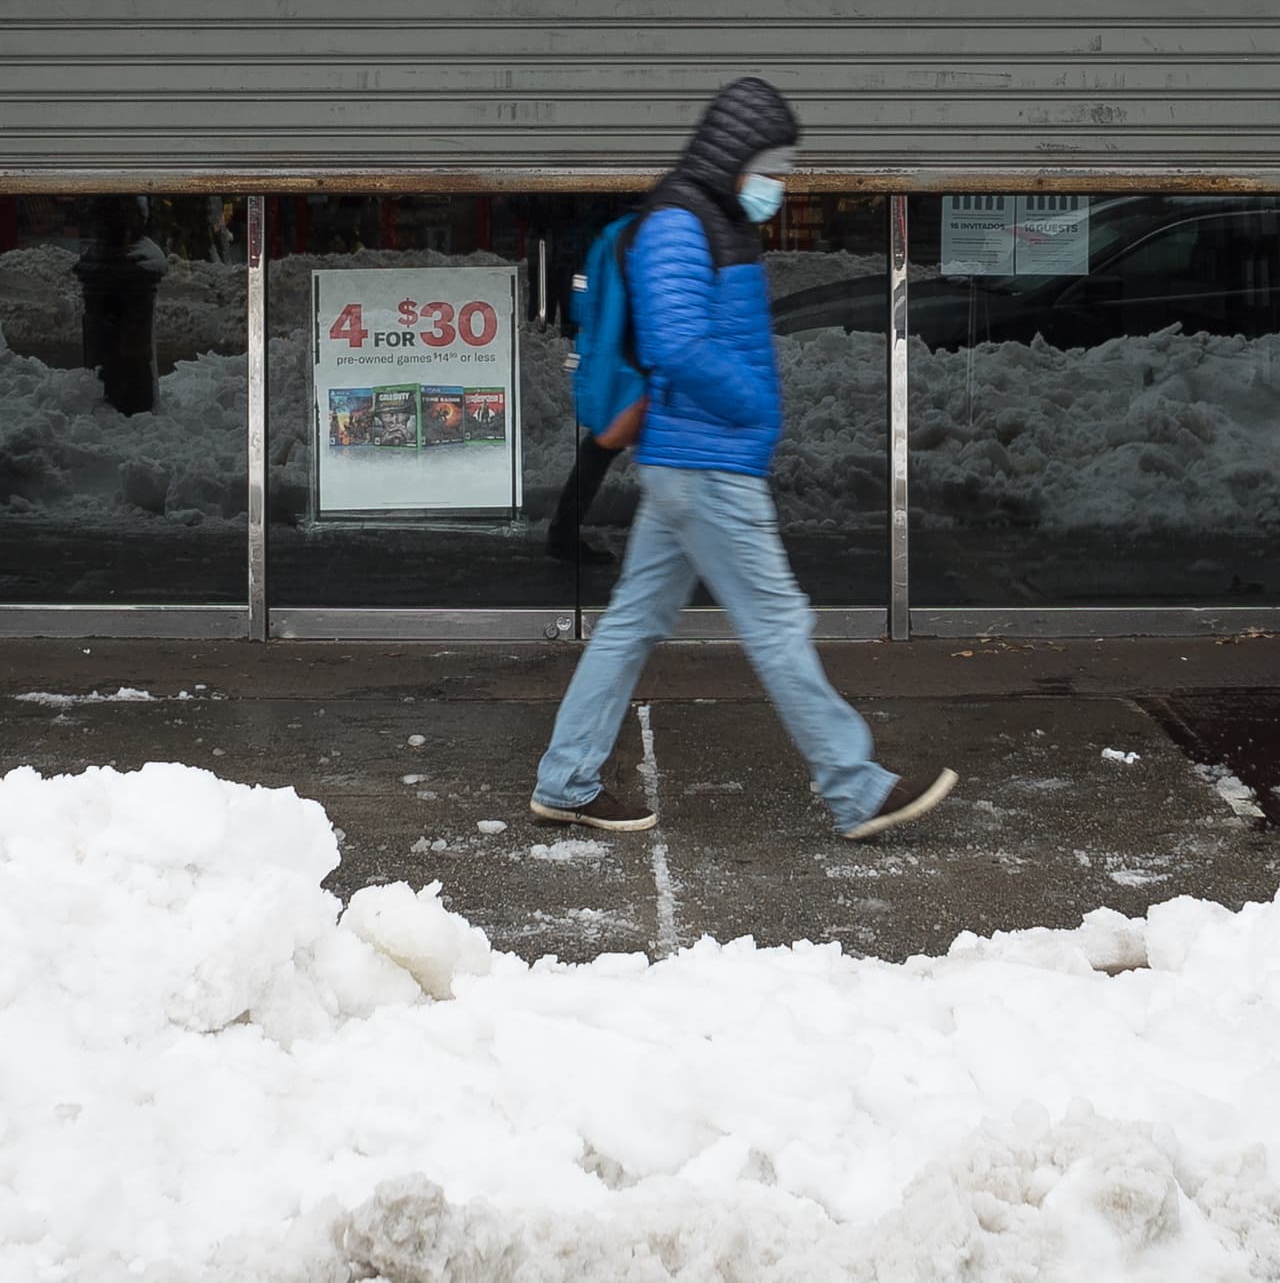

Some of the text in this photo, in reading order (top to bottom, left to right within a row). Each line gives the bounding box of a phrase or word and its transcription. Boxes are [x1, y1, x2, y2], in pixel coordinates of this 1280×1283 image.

[960, 222, 1006, 231] INVITADOS
[1034, 224, 1078, 234] GUESTS
[329, 297, 498, 348] 4 FOR $30
[336, 353, 394, 367] pre-owned
[396, 354, 433, 366] games
[459, 353, 472, 363] or
[474, 351, 497, 363] less
